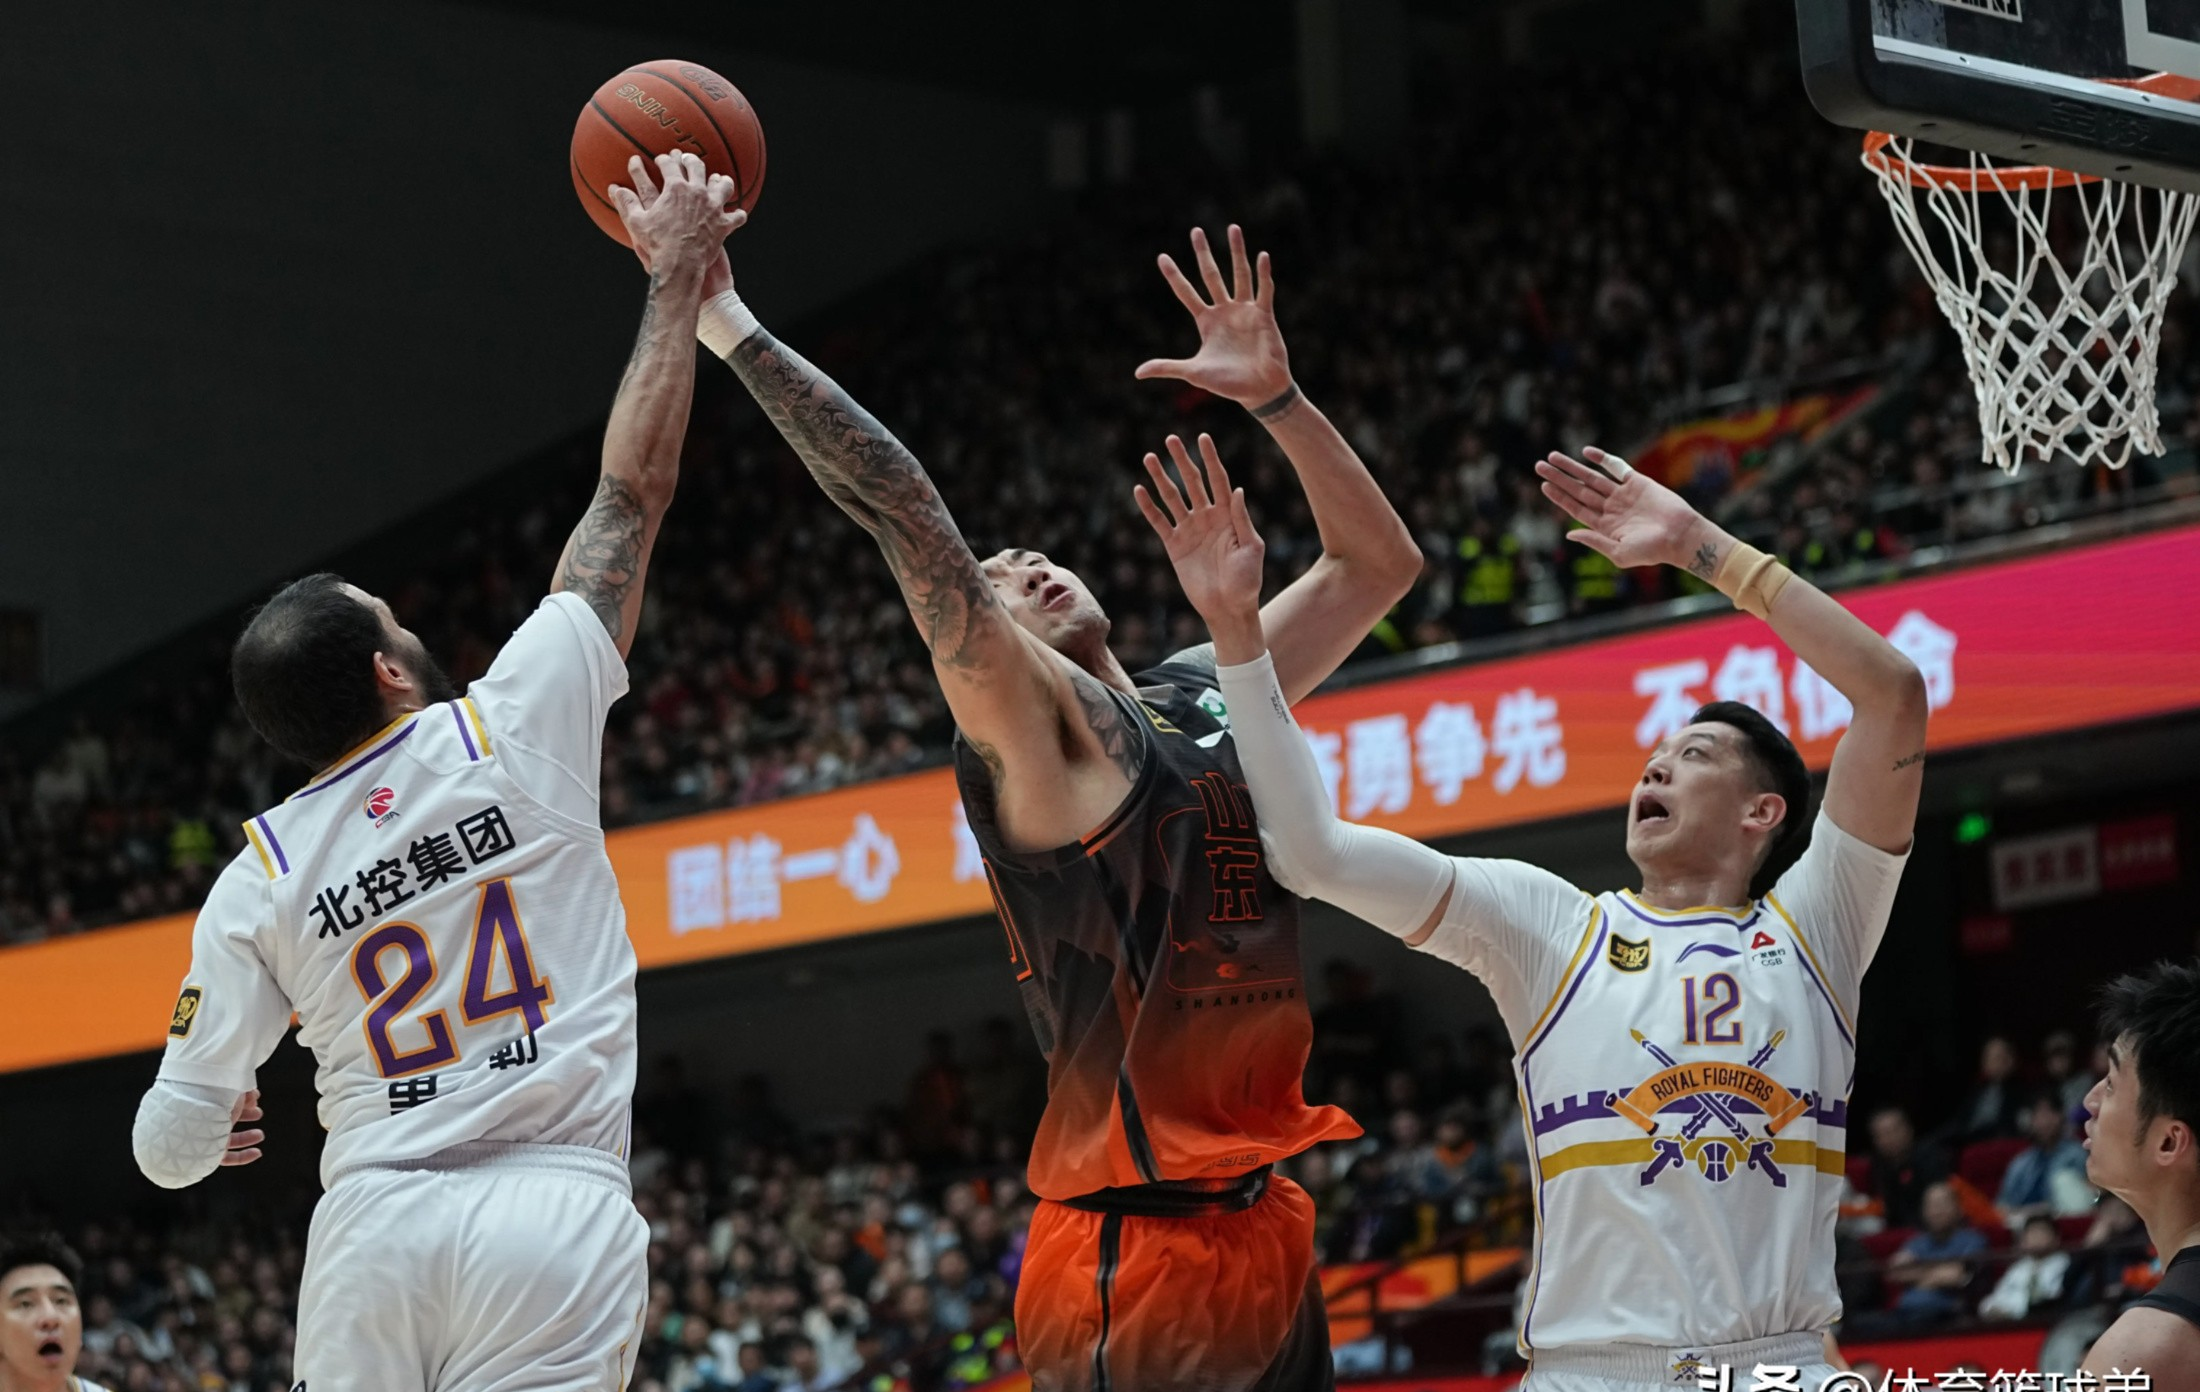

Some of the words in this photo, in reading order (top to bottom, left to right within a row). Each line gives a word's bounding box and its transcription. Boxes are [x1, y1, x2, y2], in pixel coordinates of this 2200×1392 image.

[616, 82, 708, 158] LI-NING
[308, 804, 517, 940] 北控集团
[350, 875, 555, 1080] 24
[1761, 957, 1783, 967] CGB
[1174, 988, 1295, 1011] SHANDONG
[1682, 972, 1743, 1045] 12
[1650, 1070, 1700, 1101] ROYAL
[1703, 1067, 1774, 1102] FIGHTERS
